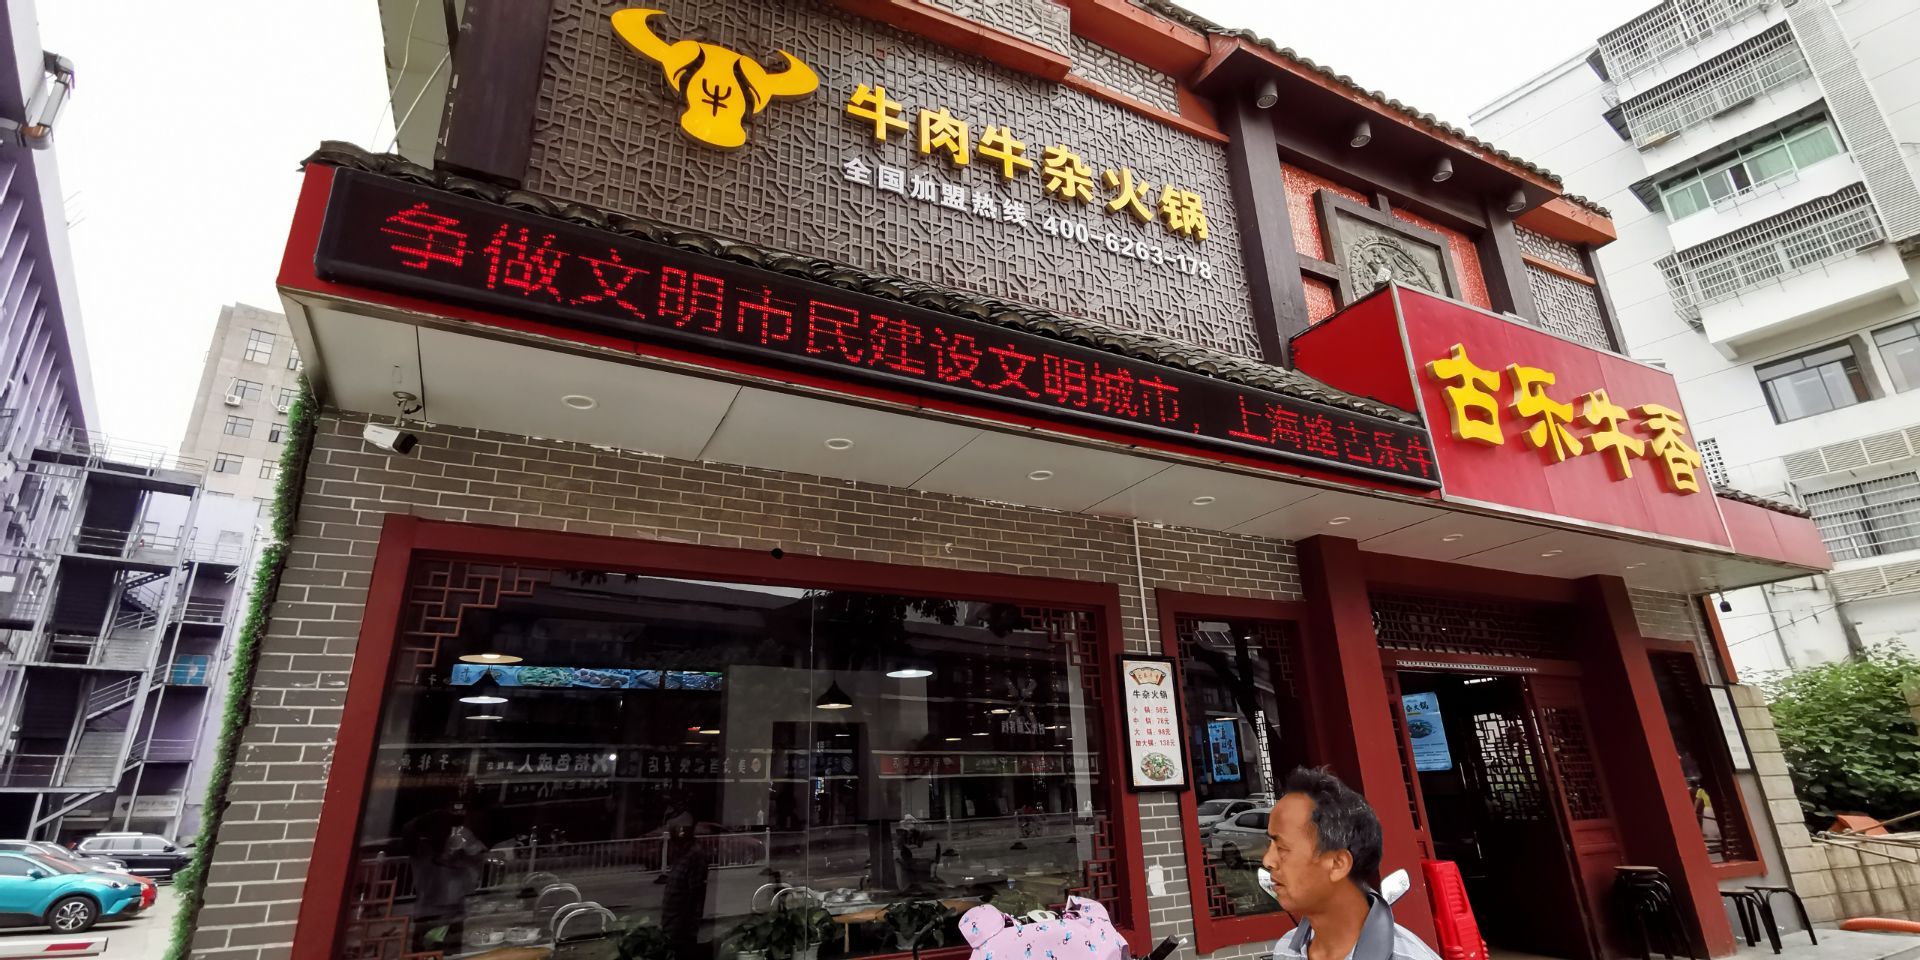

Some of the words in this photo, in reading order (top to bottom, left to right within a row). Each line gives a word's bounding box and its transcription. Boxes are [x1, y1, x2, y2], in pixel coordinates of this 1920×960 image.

[843, 157, 1029, 229] 全国加盟热线
[1042, 215, 1213, 281] 400-6263-178
[847, 83, 1209, 241] 牛肉牛杂火锅
[1425, 343, 1701, 493] 古乐牛香
[1133, 690, 1168, 699] 牛杂火锅
